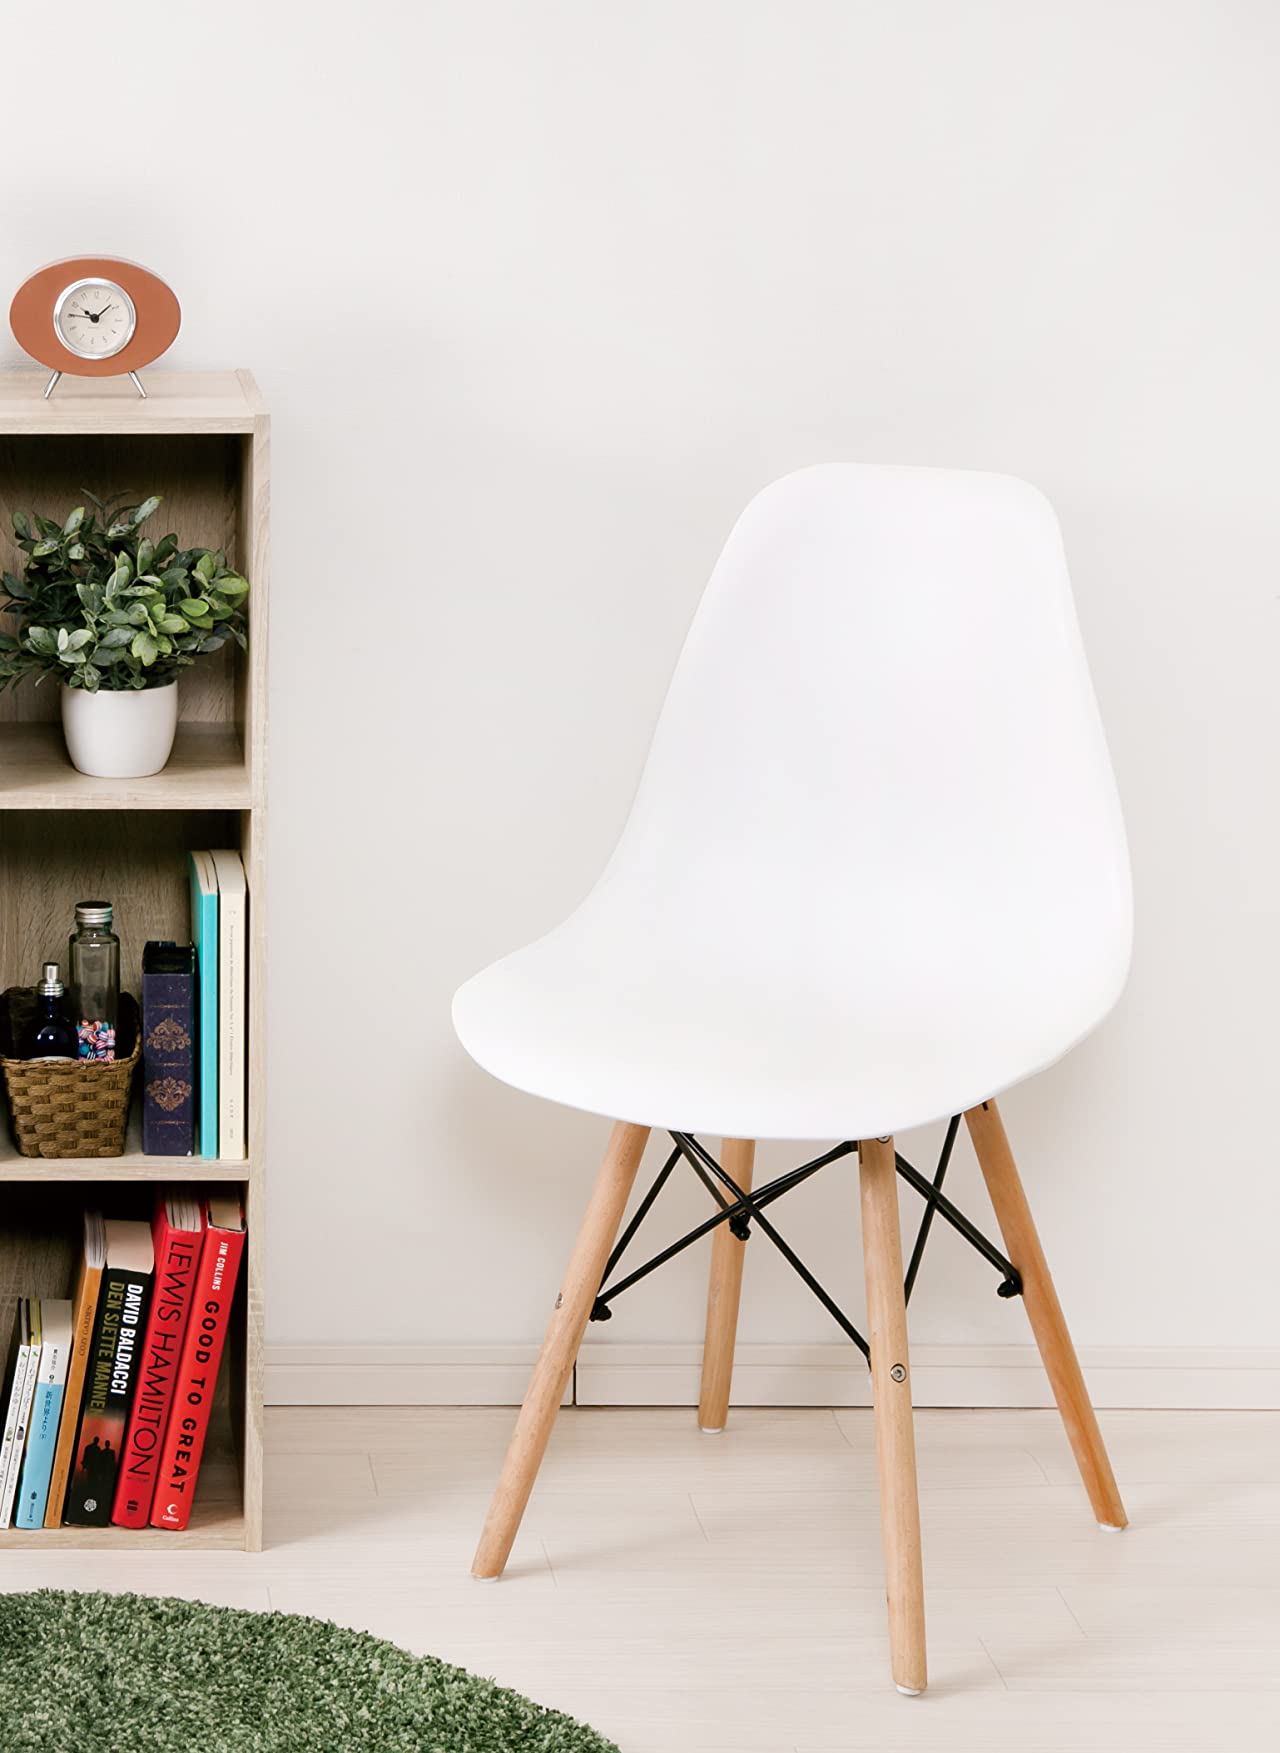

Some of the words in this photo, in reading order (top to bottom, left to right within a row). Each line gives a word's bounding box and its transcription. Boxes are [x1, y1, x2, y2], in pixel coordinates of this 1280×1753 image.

[219, 1241, 229, 1255] JIM
[157, 1241, 194, 1322] LEWIS
[212, 1257, 226, 1291] COLLINS
[106, 1281, 125, 1310] DEN
[122, 1283, 143, 1325] DAVID
[83, 1304, 92, 1334] GARDEN
[98, 1312, 120, 1358] SJETTE
[195, 1301, 220, 1364] GOOD
[79, 1334, 88, 1357] COZY
[110, 1327, 136, 1395] BALDACCI
[88, 1361, 112, 1416] MANNEN
[127, 1331, 176, 1476] HAMILTON
[187, 1377, 206, 1405] TO
[170, 1417, 197, 1493] GREAT
[162, 1515, 179, 1523] Collins
